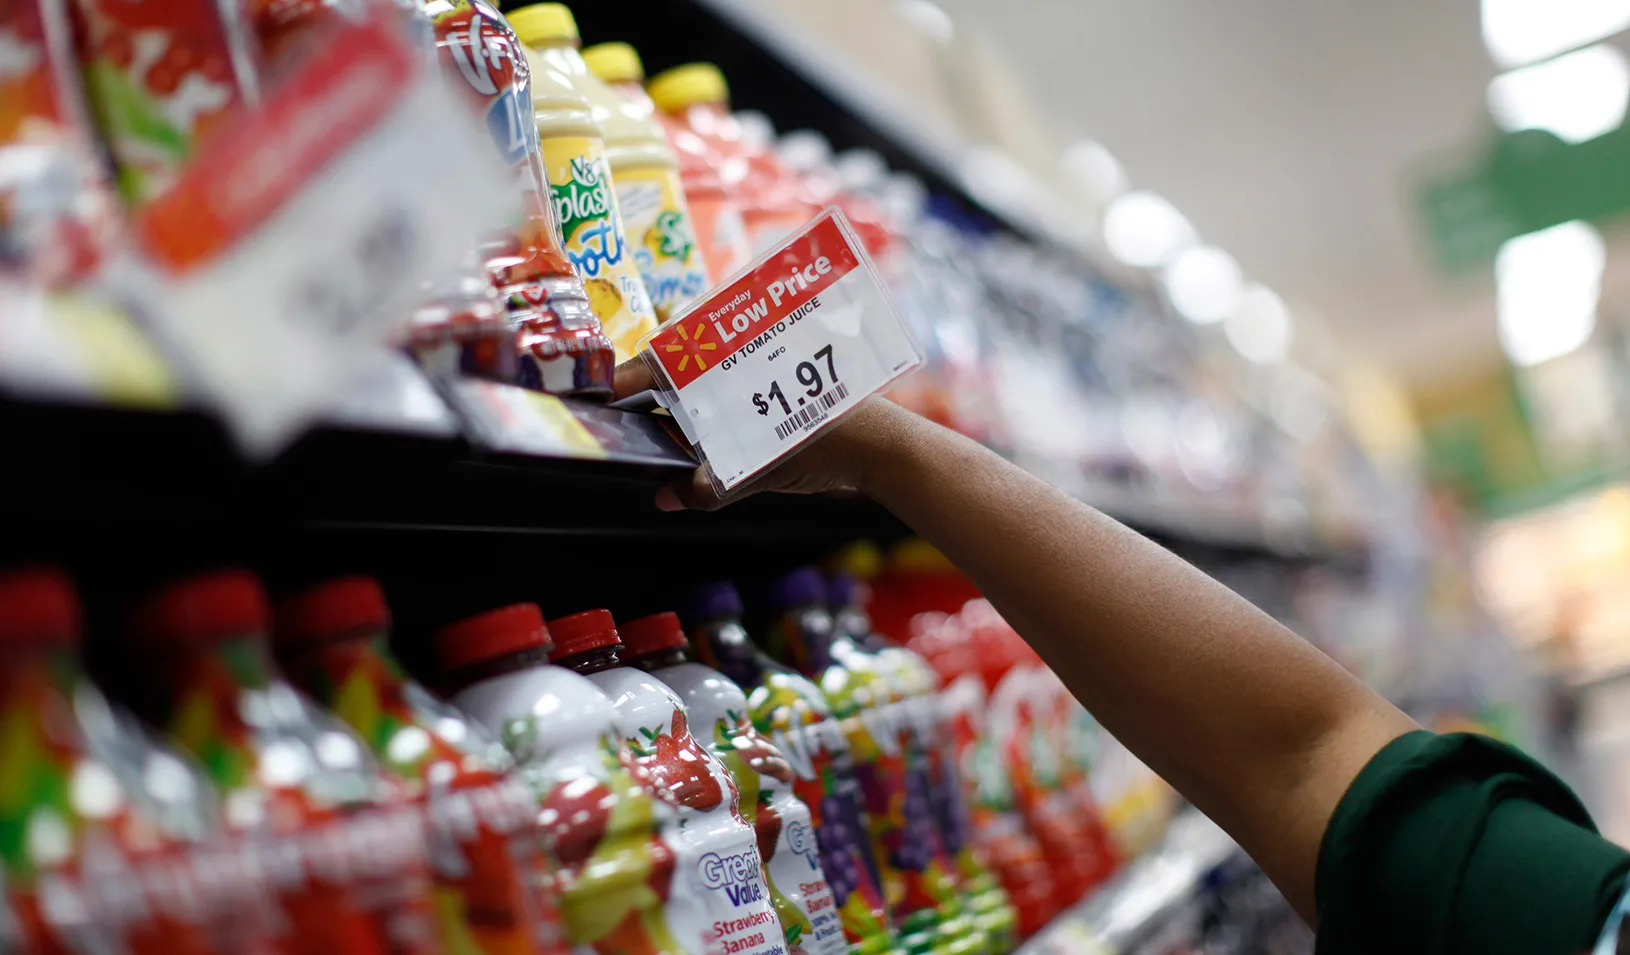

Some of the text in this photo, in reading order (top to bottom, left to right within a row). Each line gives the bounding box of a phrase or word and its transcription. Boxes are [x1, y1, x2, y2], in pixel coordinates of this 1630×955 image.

[569, 155, 596, 184] V8
[708, 289, 752, 322] Everyday
[714, 255, 833, 344] Low Price
[721, 296, 821, 371] GV TOMATO JUICE
[767, 345, 786, 362] 64FO
[752, 343, 838, 416] $1.97
[697, 845, 759, 890] Great
[725, 879, 762, 907] Value
[713, 911, 775, 938] Strawberry
[721, 932, 765, 955] Banana
